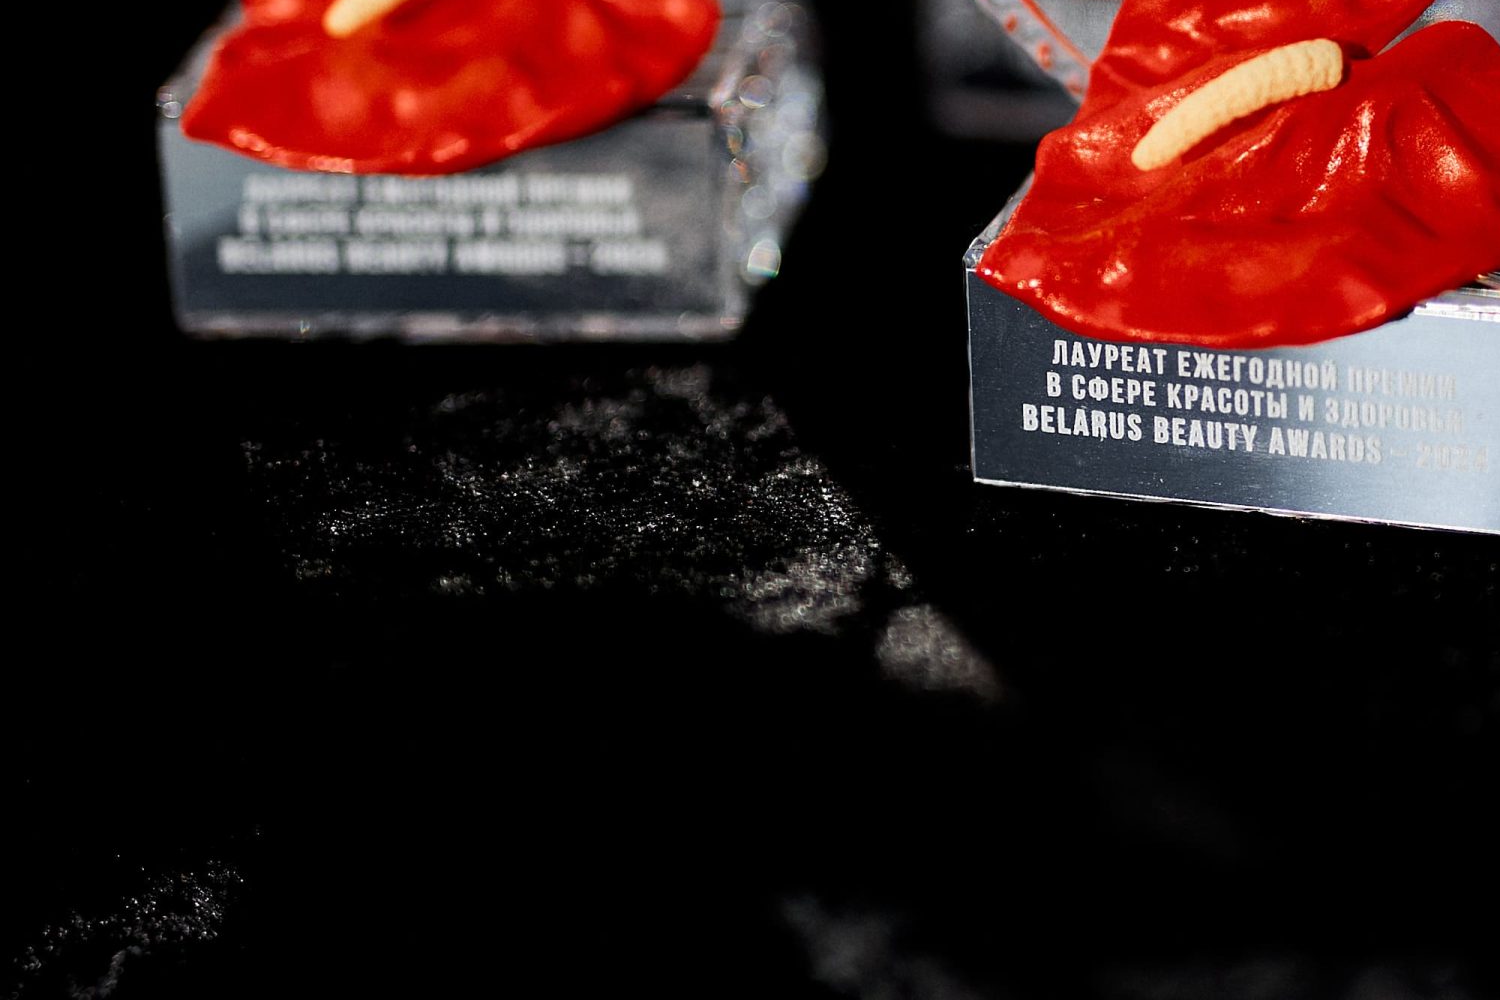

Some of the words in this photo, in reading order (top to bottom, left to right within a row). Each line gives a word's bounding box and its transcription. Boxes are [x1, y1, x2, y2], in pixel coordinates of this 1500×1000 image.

[1052, 339, 1168, 376] ЛАУРЕАТ
[1177, 350, 1338, 392] ЕЖЕГОДНОЙ
[1046, 371, 1062, 398] В
[1071, 373, 1157, 407] СФЕРЕ
[1166, 382, 1288, 420] КРАСОТЫ
[1298, 394, 1315, 422] И
[1325, 396, 1463, 434] ЗДОРОВЬЯ
[1022, 403, 1142, 442] BELARUS
[1153, 415, 1258, 453] BEAUTY
[1268, 426, 1382, 466] AWARDS
